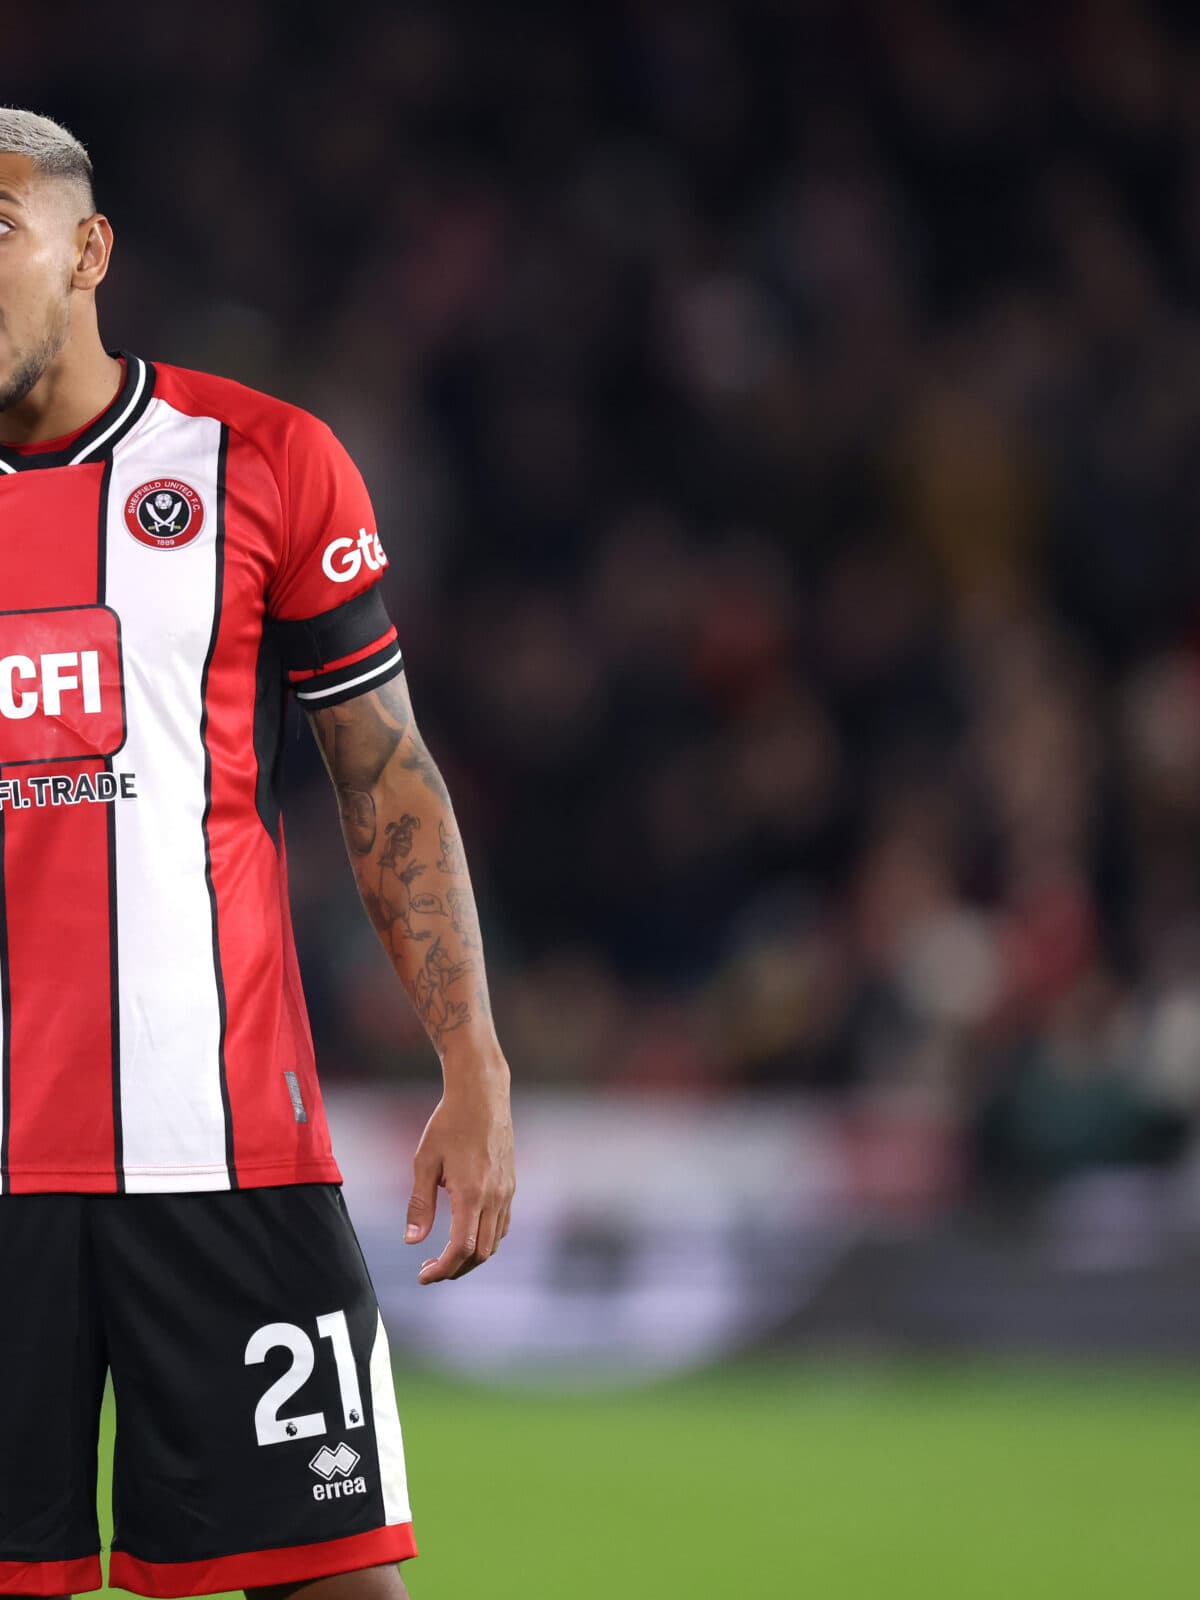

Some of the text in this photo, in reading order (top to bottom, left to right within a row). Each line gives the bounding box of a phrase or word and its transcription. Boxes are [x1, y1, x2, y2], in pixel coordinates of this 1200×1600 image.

[128, 482, 161, 514] SHEFFIELD
[164, 481, 193, 497] UNITED
[244, 1309, 365, 1446] 21
